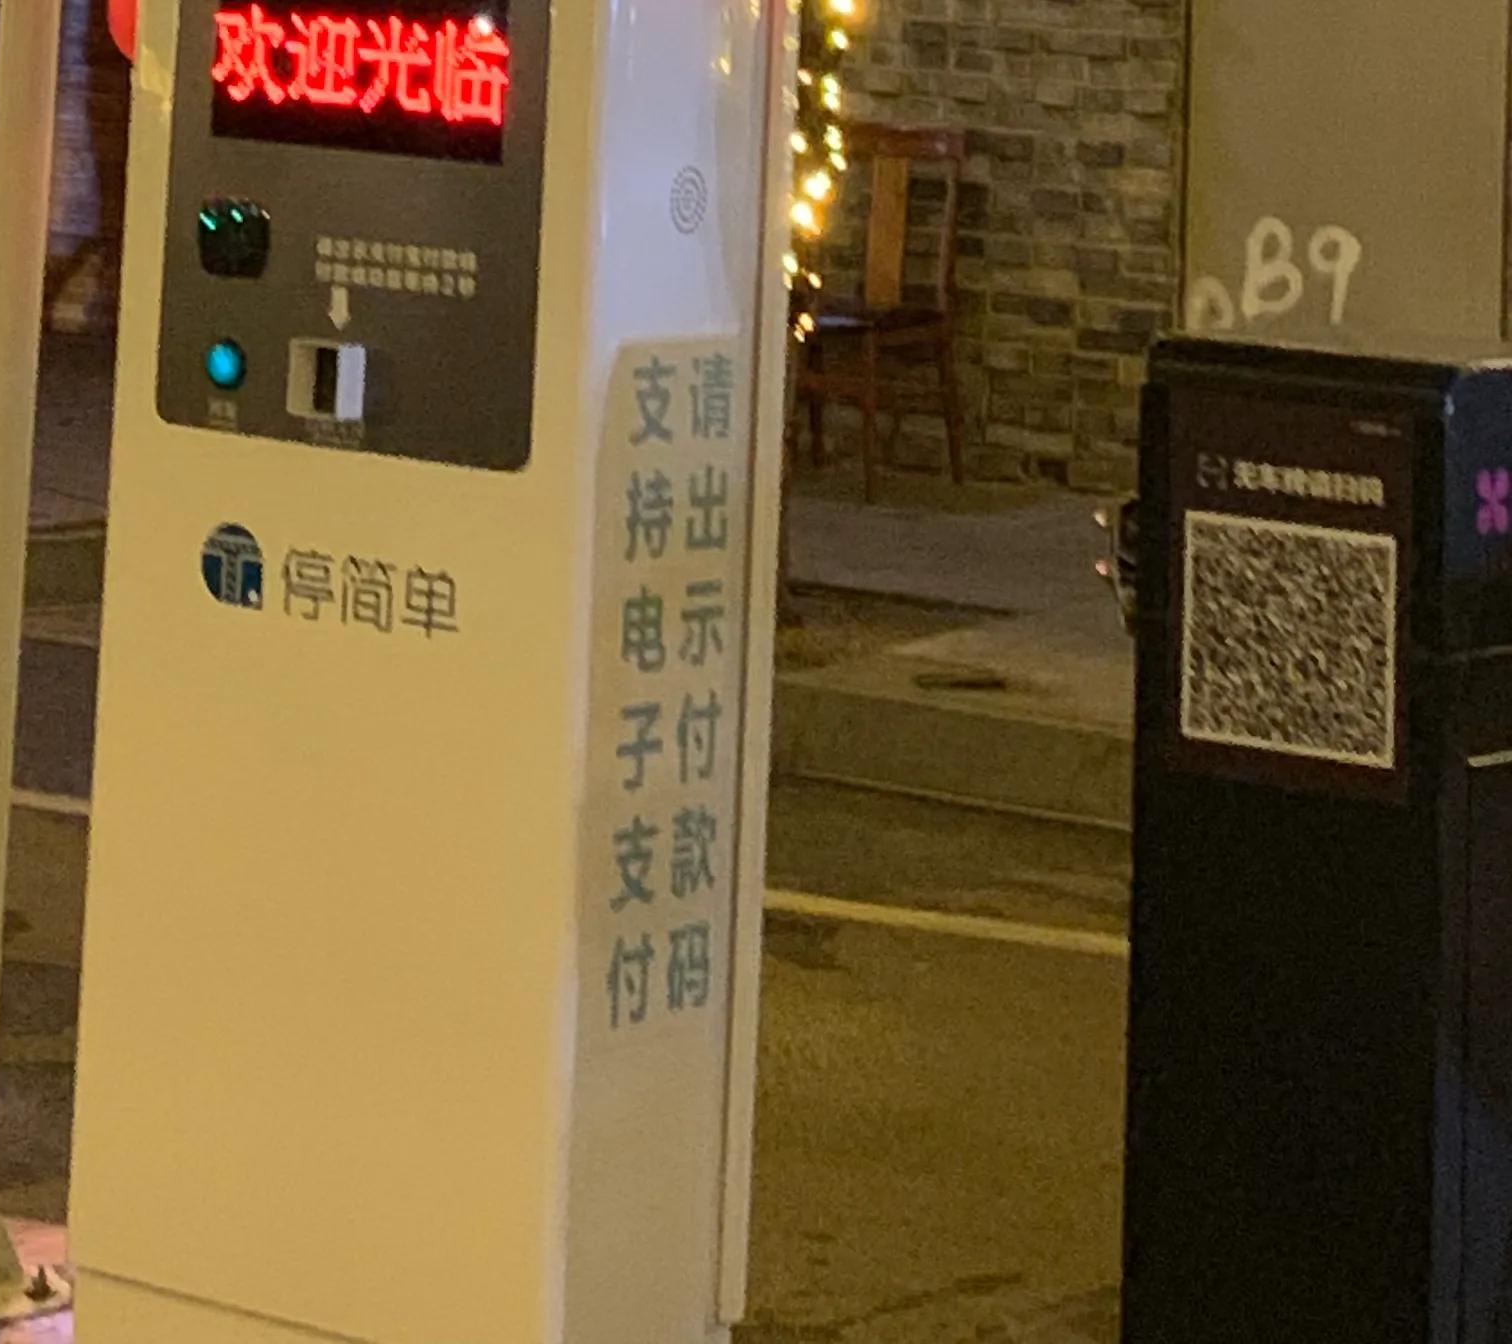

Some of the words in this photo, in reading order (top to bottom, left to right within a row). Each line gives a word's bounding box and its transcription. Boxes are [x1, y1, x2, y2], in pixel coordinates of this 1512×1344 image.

[211, 3, 511, 126] 欢迎光临
[282, 545, 459, 638] 停简单
[606, 356, 677, 1030] 支持电子支付
[666, 354, 735, 1010] 请出示付款码
